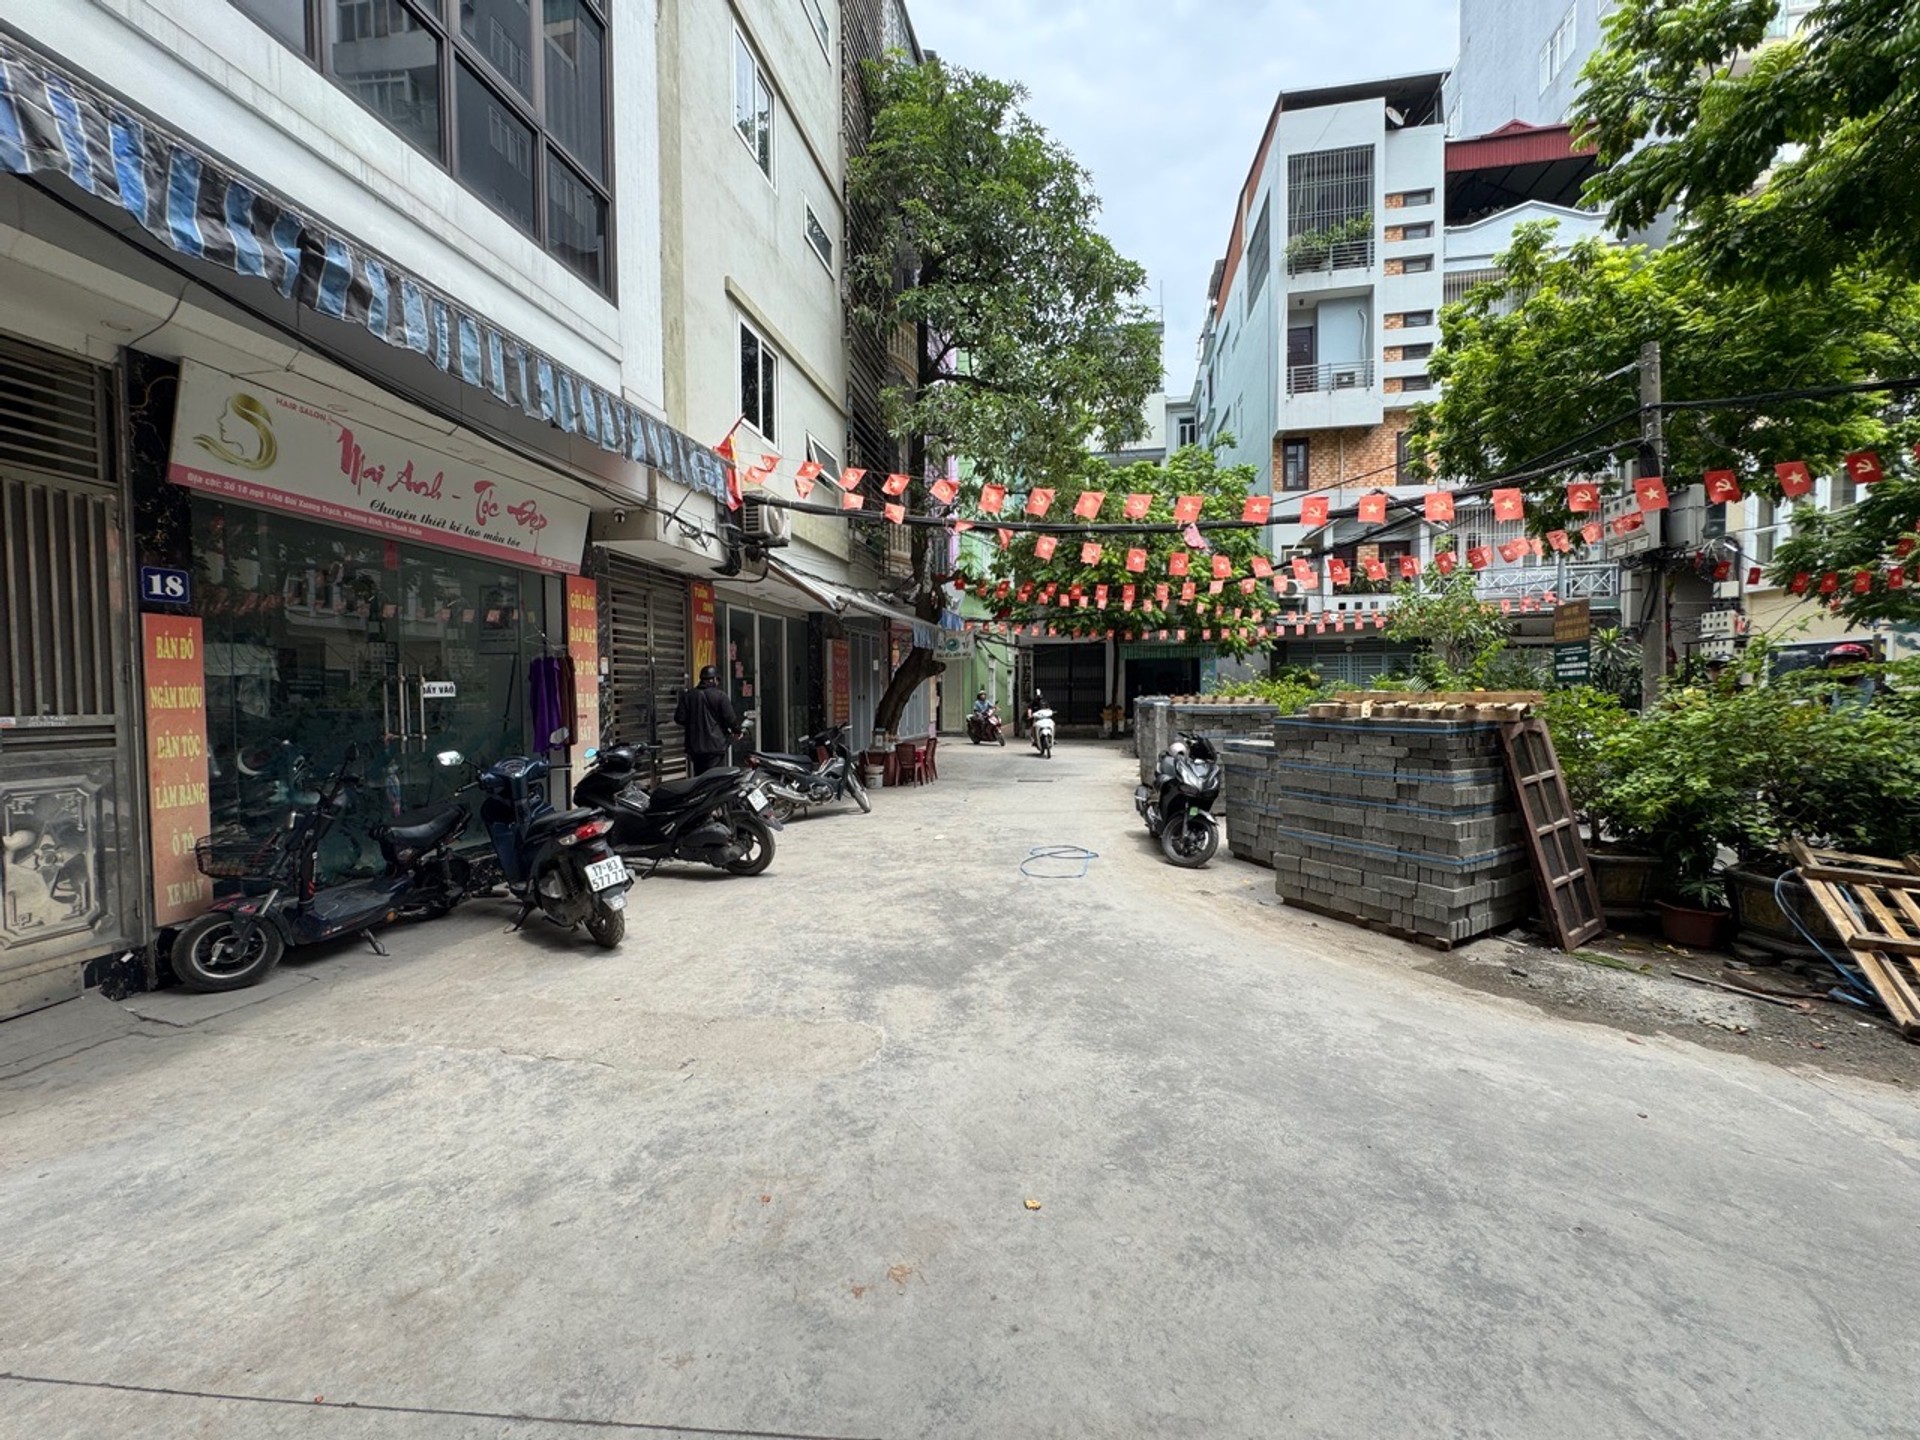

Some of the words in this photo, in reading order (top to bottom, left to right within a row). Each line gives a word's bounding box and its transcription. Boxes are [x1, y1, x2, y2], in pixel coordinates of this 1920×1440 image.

[276, 397, 297, 411] HAIR
[299, 405, 327, 422] SALON
[223, 480, 236, 491] Số
[332, 421, 386, 496] Mai
[387, 459, 444, 500] Anh
[474, 480, 501, 526] Tóc
[369, 499, 418, 521] Chuyên
[420, 512, 447, 529] thiết
[148, 574, 184, 597] 18
[155, 630, 178, 659] BÁN
[150, 680, 177, 709] NGÂM
[179, 681, 202, 714] RƯỢU
[181, 729, 201, 763] TỘC
[155, 780, 178, 810] LÀM
[179, 772, 206, 807] BẰNG
[172, 827, 180, 856] Ô
[166, 882, 181, 907] XE
[182, 873, 204, 902] MÁY
